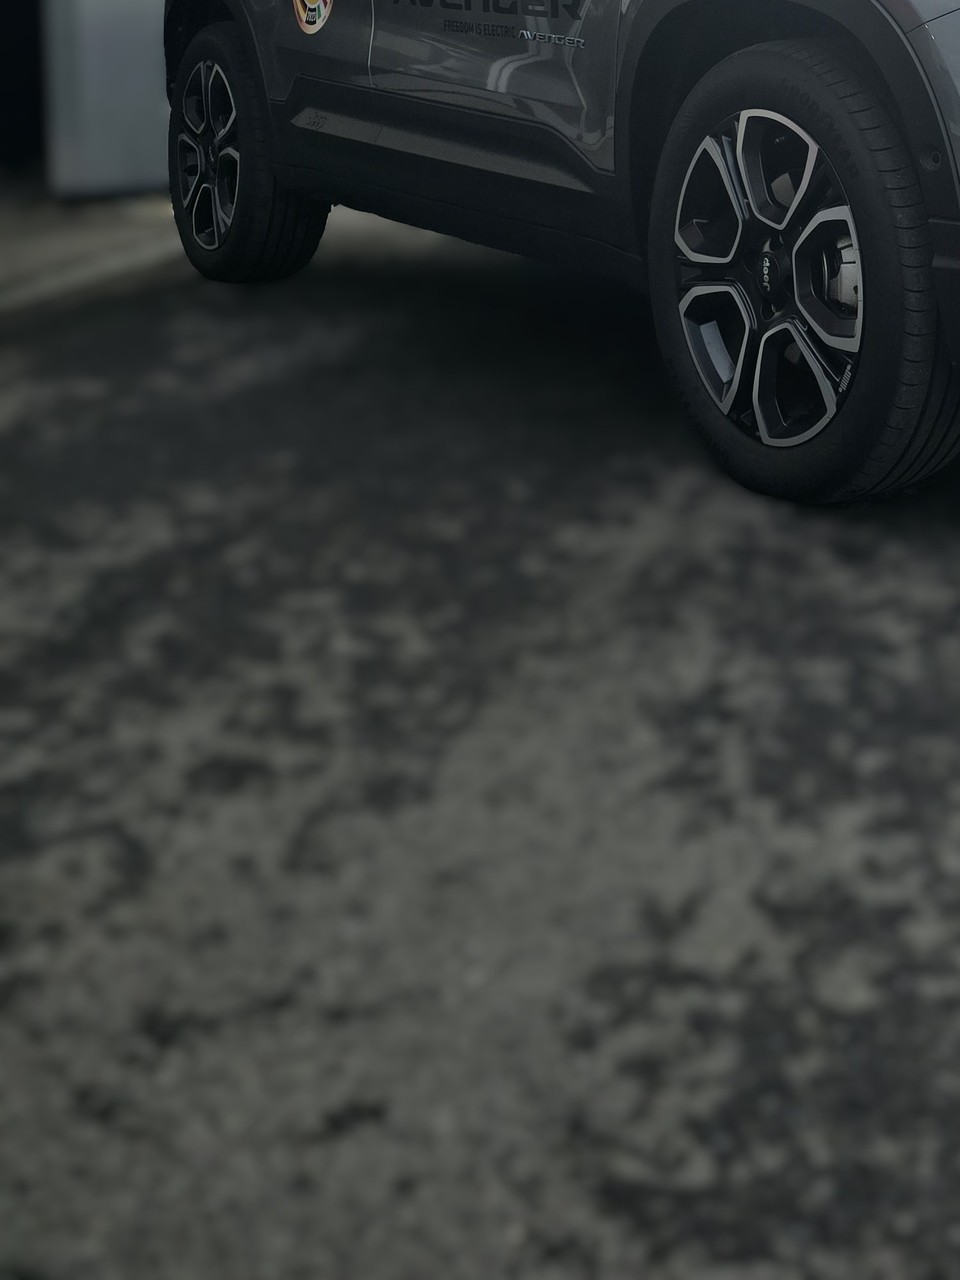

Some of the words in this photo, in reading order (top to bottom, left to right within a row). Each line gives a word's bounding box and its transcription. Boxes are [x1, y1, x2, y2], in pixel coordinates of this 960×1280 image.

[443, 20, 474, 34] FREEDOM
[475, 23, 482, 35] IS
[484, 23, 516, 39] ELECTRIC
[517, 29, 585, 48] AVENGER
